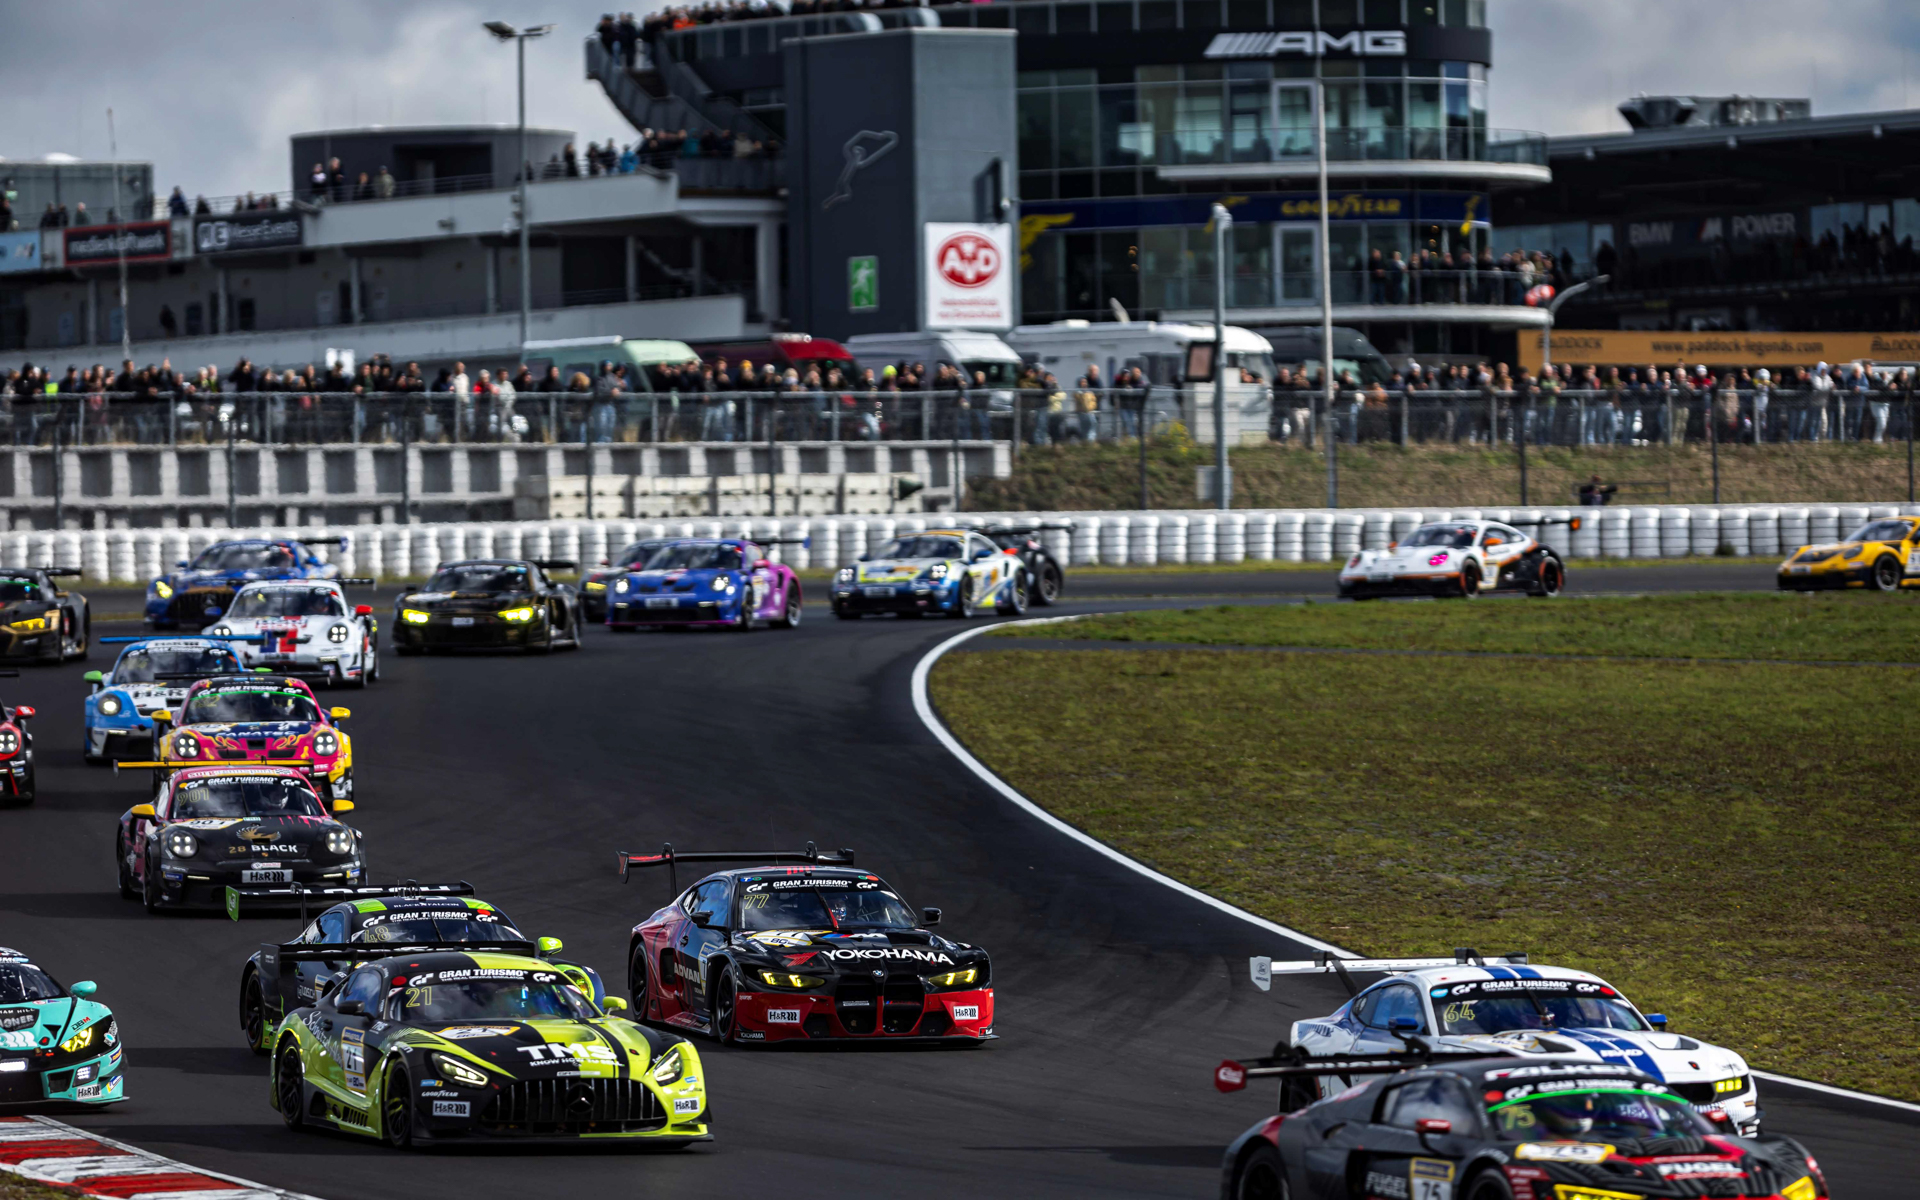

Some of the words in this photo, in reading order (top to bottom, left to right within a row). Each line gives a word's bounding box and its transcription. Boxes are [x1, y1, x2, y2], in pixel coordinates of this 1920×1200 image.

[1271, 31, 1407, 56] AMG
[1281, 194, 1402, 218] GOODYEAR
[1731, 212, 1796, 238] POWER
[207, 777, 232, 785] GRAN
[234, 775, 274, 784] TURISMO
[177, 787, 210, 806] 901
[228, 845, 247, 855] 28
[251, 844, 299, 854] BLACK
[772, 880, 802, 888] GRAN
[803, 879, 849, 887] TURISMO
[743, 894, 770, 910] 77
[389, 912, 419, 921] GRAN
[421, 911, 467, 919] TURISMO
[821, 948, 956, 966] YOKOHAMA
[438, 970, 472, 979] GRAN
[473, 968, 524, 977] TURISMO
[673, 962, 701, 984] ADVAN
[1481, 980, 1514, 989] GRAN
[1516, 980, 1567, 988] TURISMO
[405, 986, 433, 1008] 21
[1443, 1003, 1476, 1023] 64
[516, 1042, 618, 1060] TMS
[529, 1058, 560, 1067] KNOW
[421, 1089, 458, 1098] GOODYEAR
[1537, 1080, 1575, 1092] GRAN
[1577, 1079, 1634, 1090] TURISMO
[1498, 1104, 1536, 1130] 75
[1421, 1181, 1442, 1200] 75
